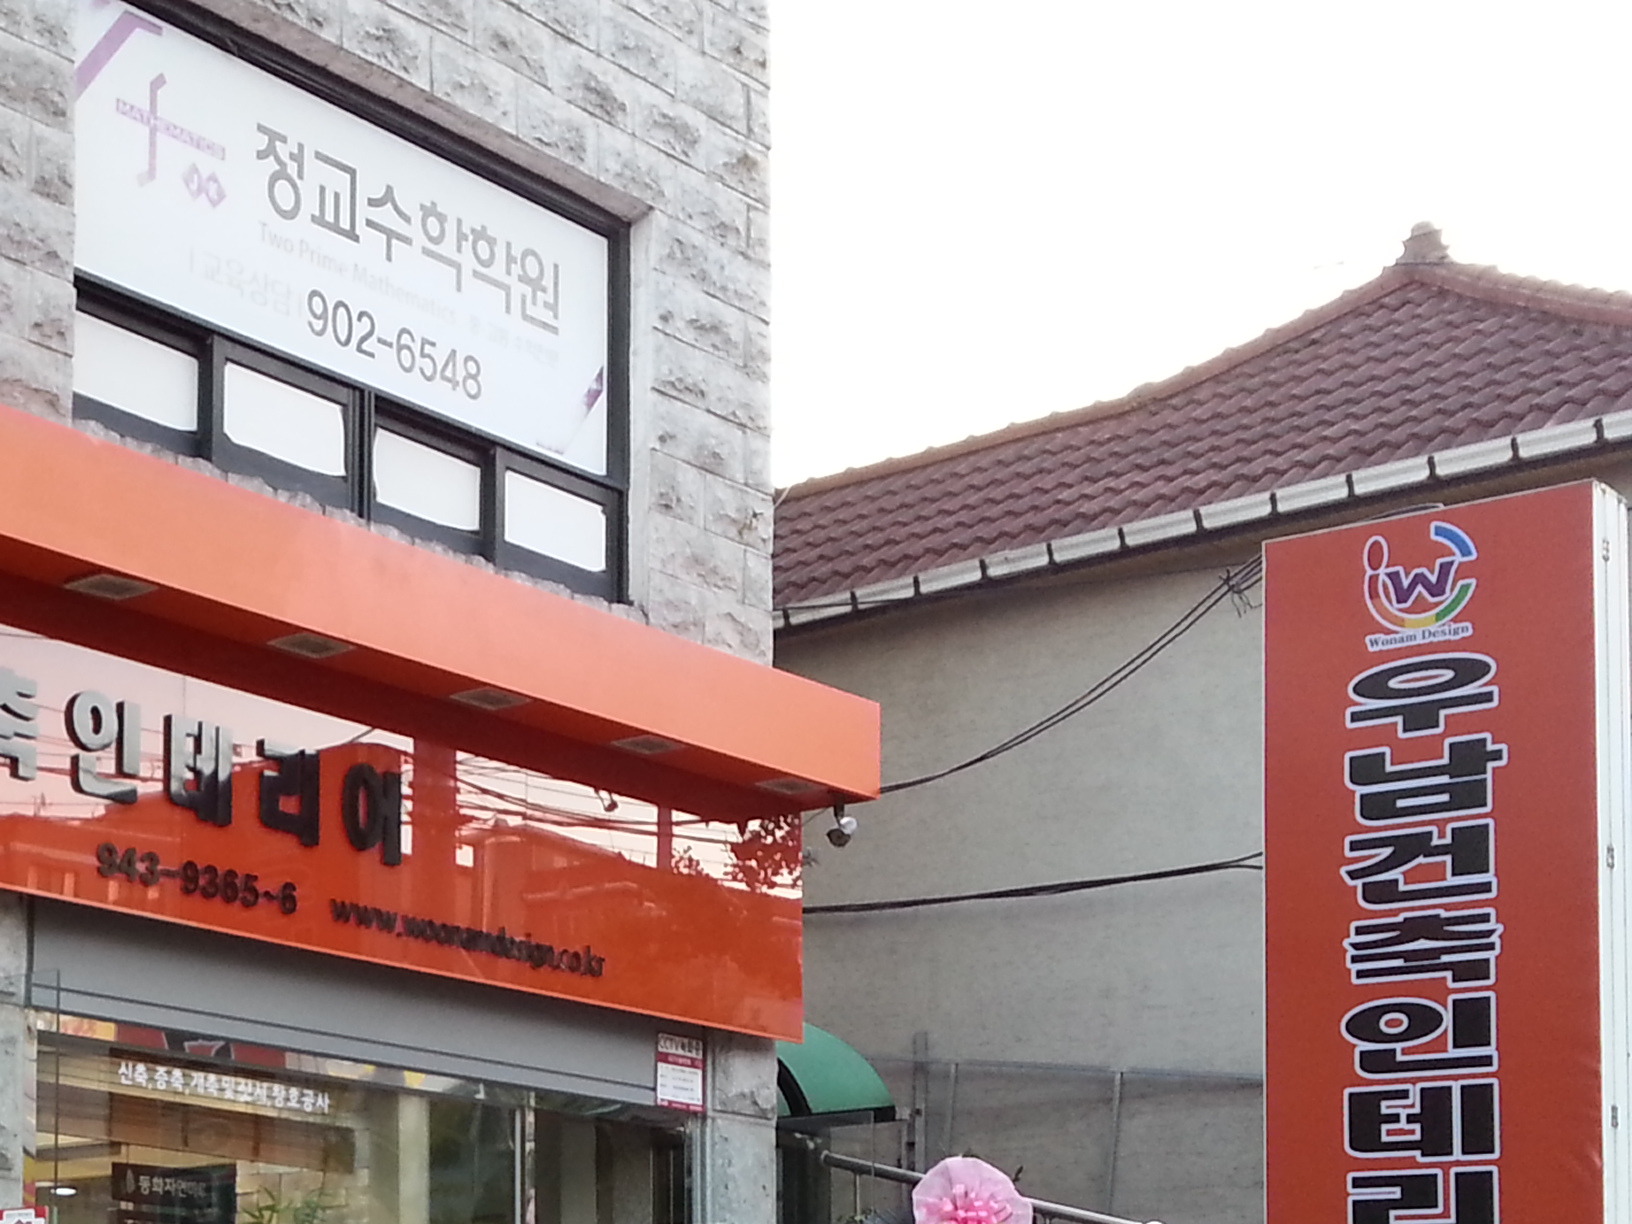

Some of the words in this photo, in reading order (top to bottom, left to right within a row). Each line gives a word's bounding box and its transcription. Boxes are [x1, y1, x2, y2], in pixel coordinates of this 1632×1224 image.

[305, 287, 484, 402] 902-6548
[1368, 631, 1420, 650] Wonam
[1420, 622, 1471, 643] Design
